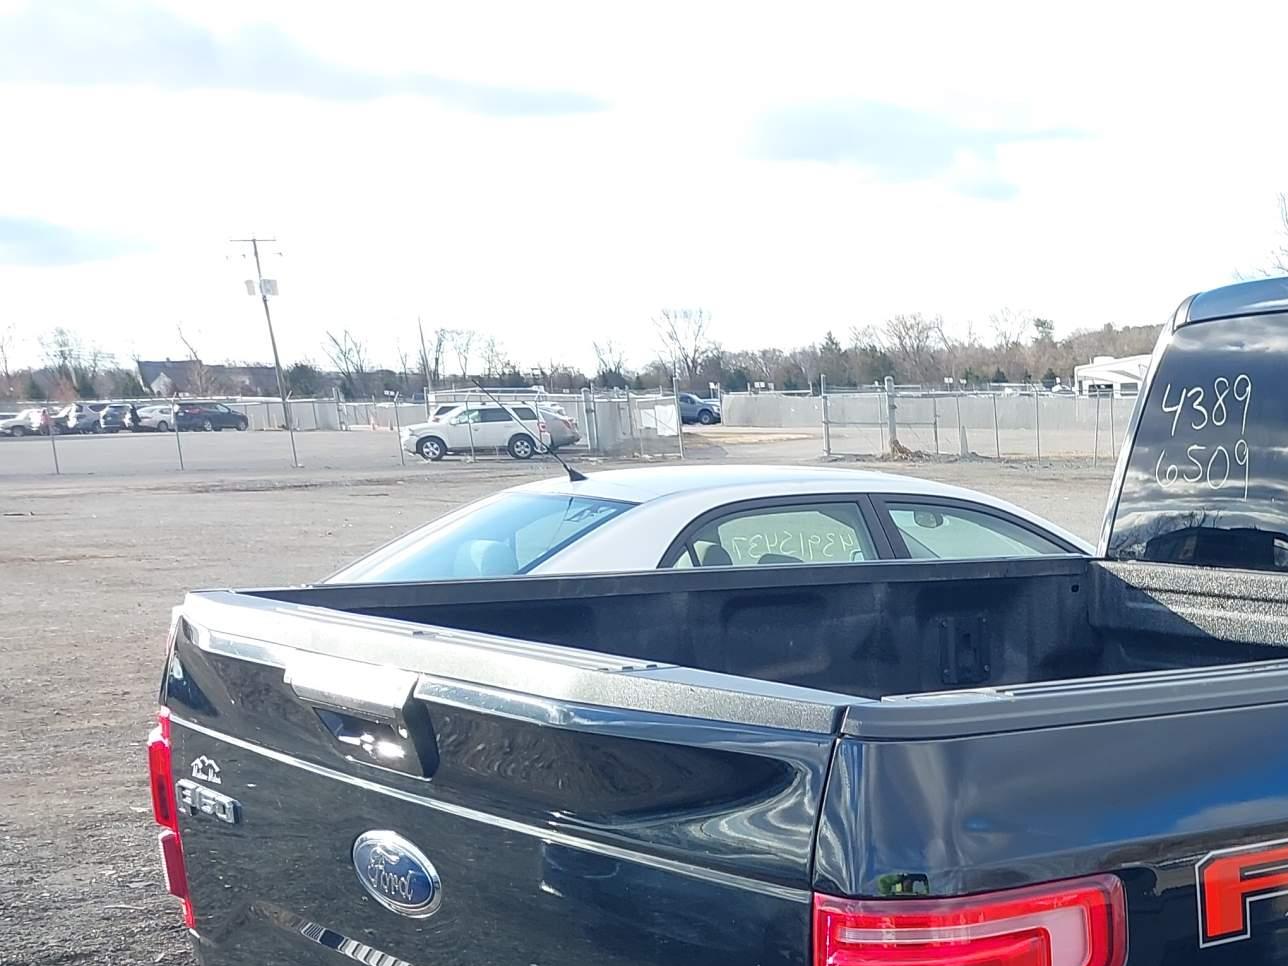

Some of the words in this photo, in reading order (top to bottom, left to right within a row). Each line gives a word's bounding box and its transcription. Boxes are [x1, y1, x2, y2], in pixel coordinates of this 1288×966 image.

[1161, 374, 1252, 437] 4389
[1155, 439, 1250, 502] 6509
[367, 844, 415, 902] Ford
